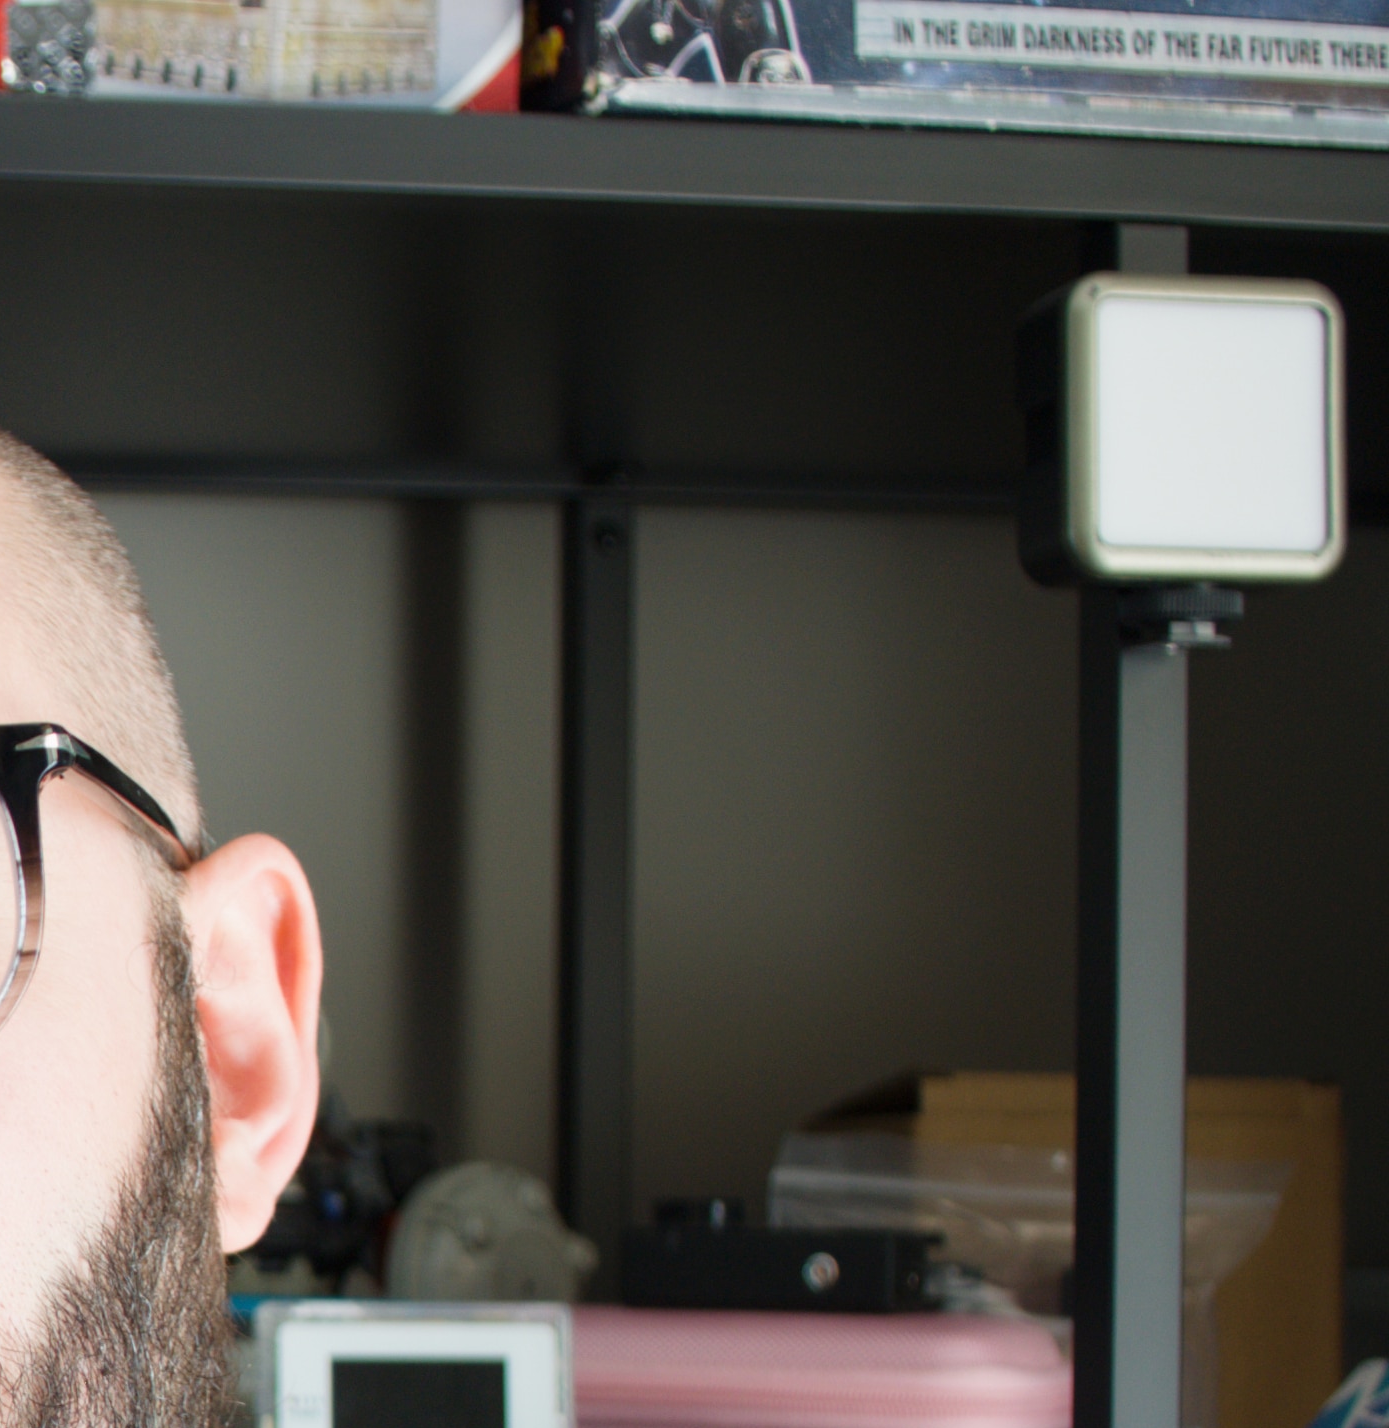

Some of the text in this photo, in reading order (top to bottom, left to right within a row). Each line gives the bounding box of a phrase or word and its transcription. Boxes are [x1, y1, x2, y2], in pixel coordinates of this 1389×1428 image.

[893, 17, 1388, 69] IN THE GRIM DARKNESS OF THE FAR FUTURE THERE
